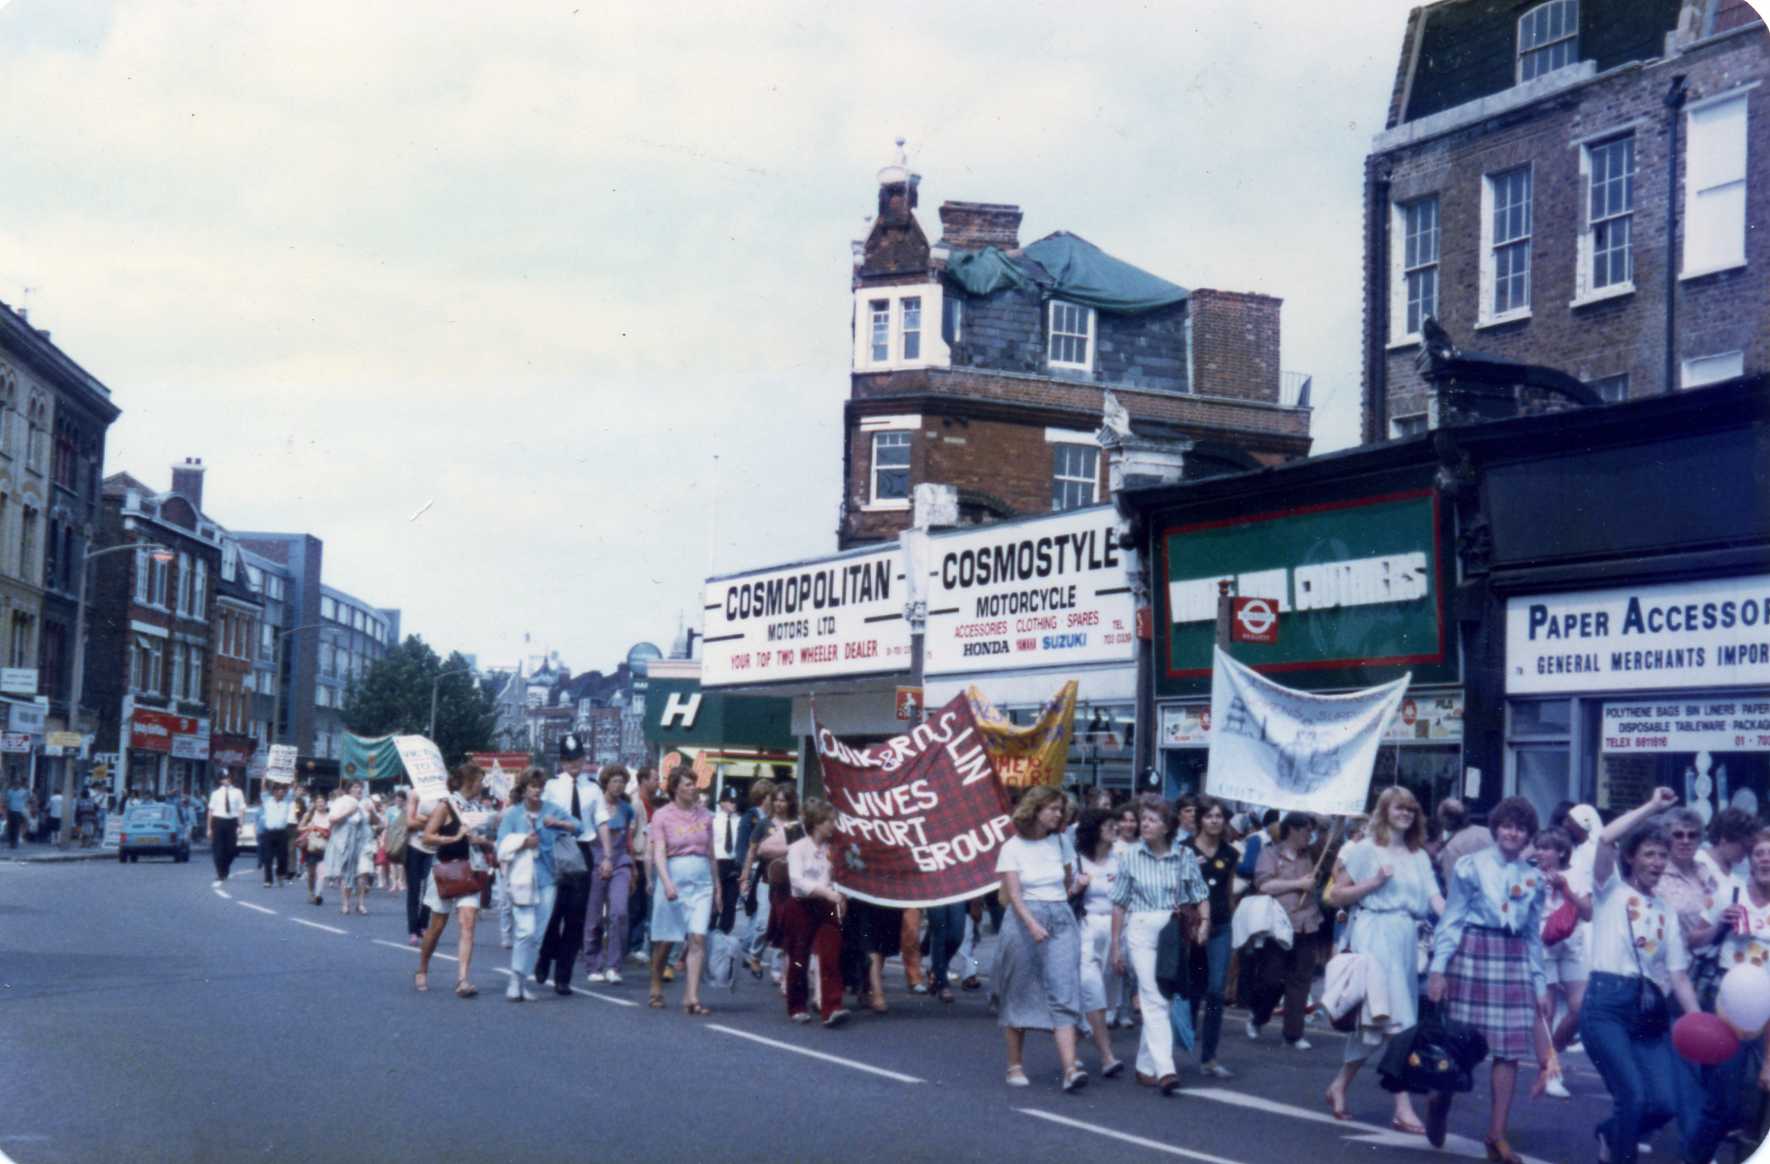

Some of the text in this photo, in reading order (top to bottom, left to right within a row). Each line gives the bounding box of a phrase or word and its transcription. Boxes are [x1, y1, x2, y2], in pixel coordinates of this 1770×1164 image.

[942, 527, 1119, 590] COSMOSTYLE
[726, 559, 891, 621] COSMOPOLITAN
[976, 585, 1076, 618] MOTORCYCLE
[768, 616, 836, 642] MOTORS LTD
[1016, 615, 1057, 634] CLOTHING
[1067, 610, 1099, 629] SPARES
[1528, 604, 1610, 640] PAPER
[731, 651, 751, 671] YOUR
[756, 650, 771, 667] TOP
[777, 648, 794, 665] TWO
[800, 644, 838, 664] WHEELER
[844, 640, 878, 660] DEALER
[963, 640, 1011, 657] HONDA
[1042, 633, 1087, 650] SUZUKI
[1536, 654, 1600, 675] GENERAL
[1611, 647, 1705, 671] MERCHANTS
[1717, 643, 1770, 667] IMPOR
[1605, 706, 1652, 718] POLYTHENE
[1656, 705, 1680, 717] BAGS
[1704, 703, 1736, 716] LINERS
[1618, 721, 1670, 733] DISPOSABLE
[1675, 720, 1726, 732] TABLEWARE
[1605, 737, 1631, 748] TELEX
[843, 779, 938, 816] WIVES
[834, 811, 929, 848] UPPORT
[911, 814, 1014, 872] GROUP
